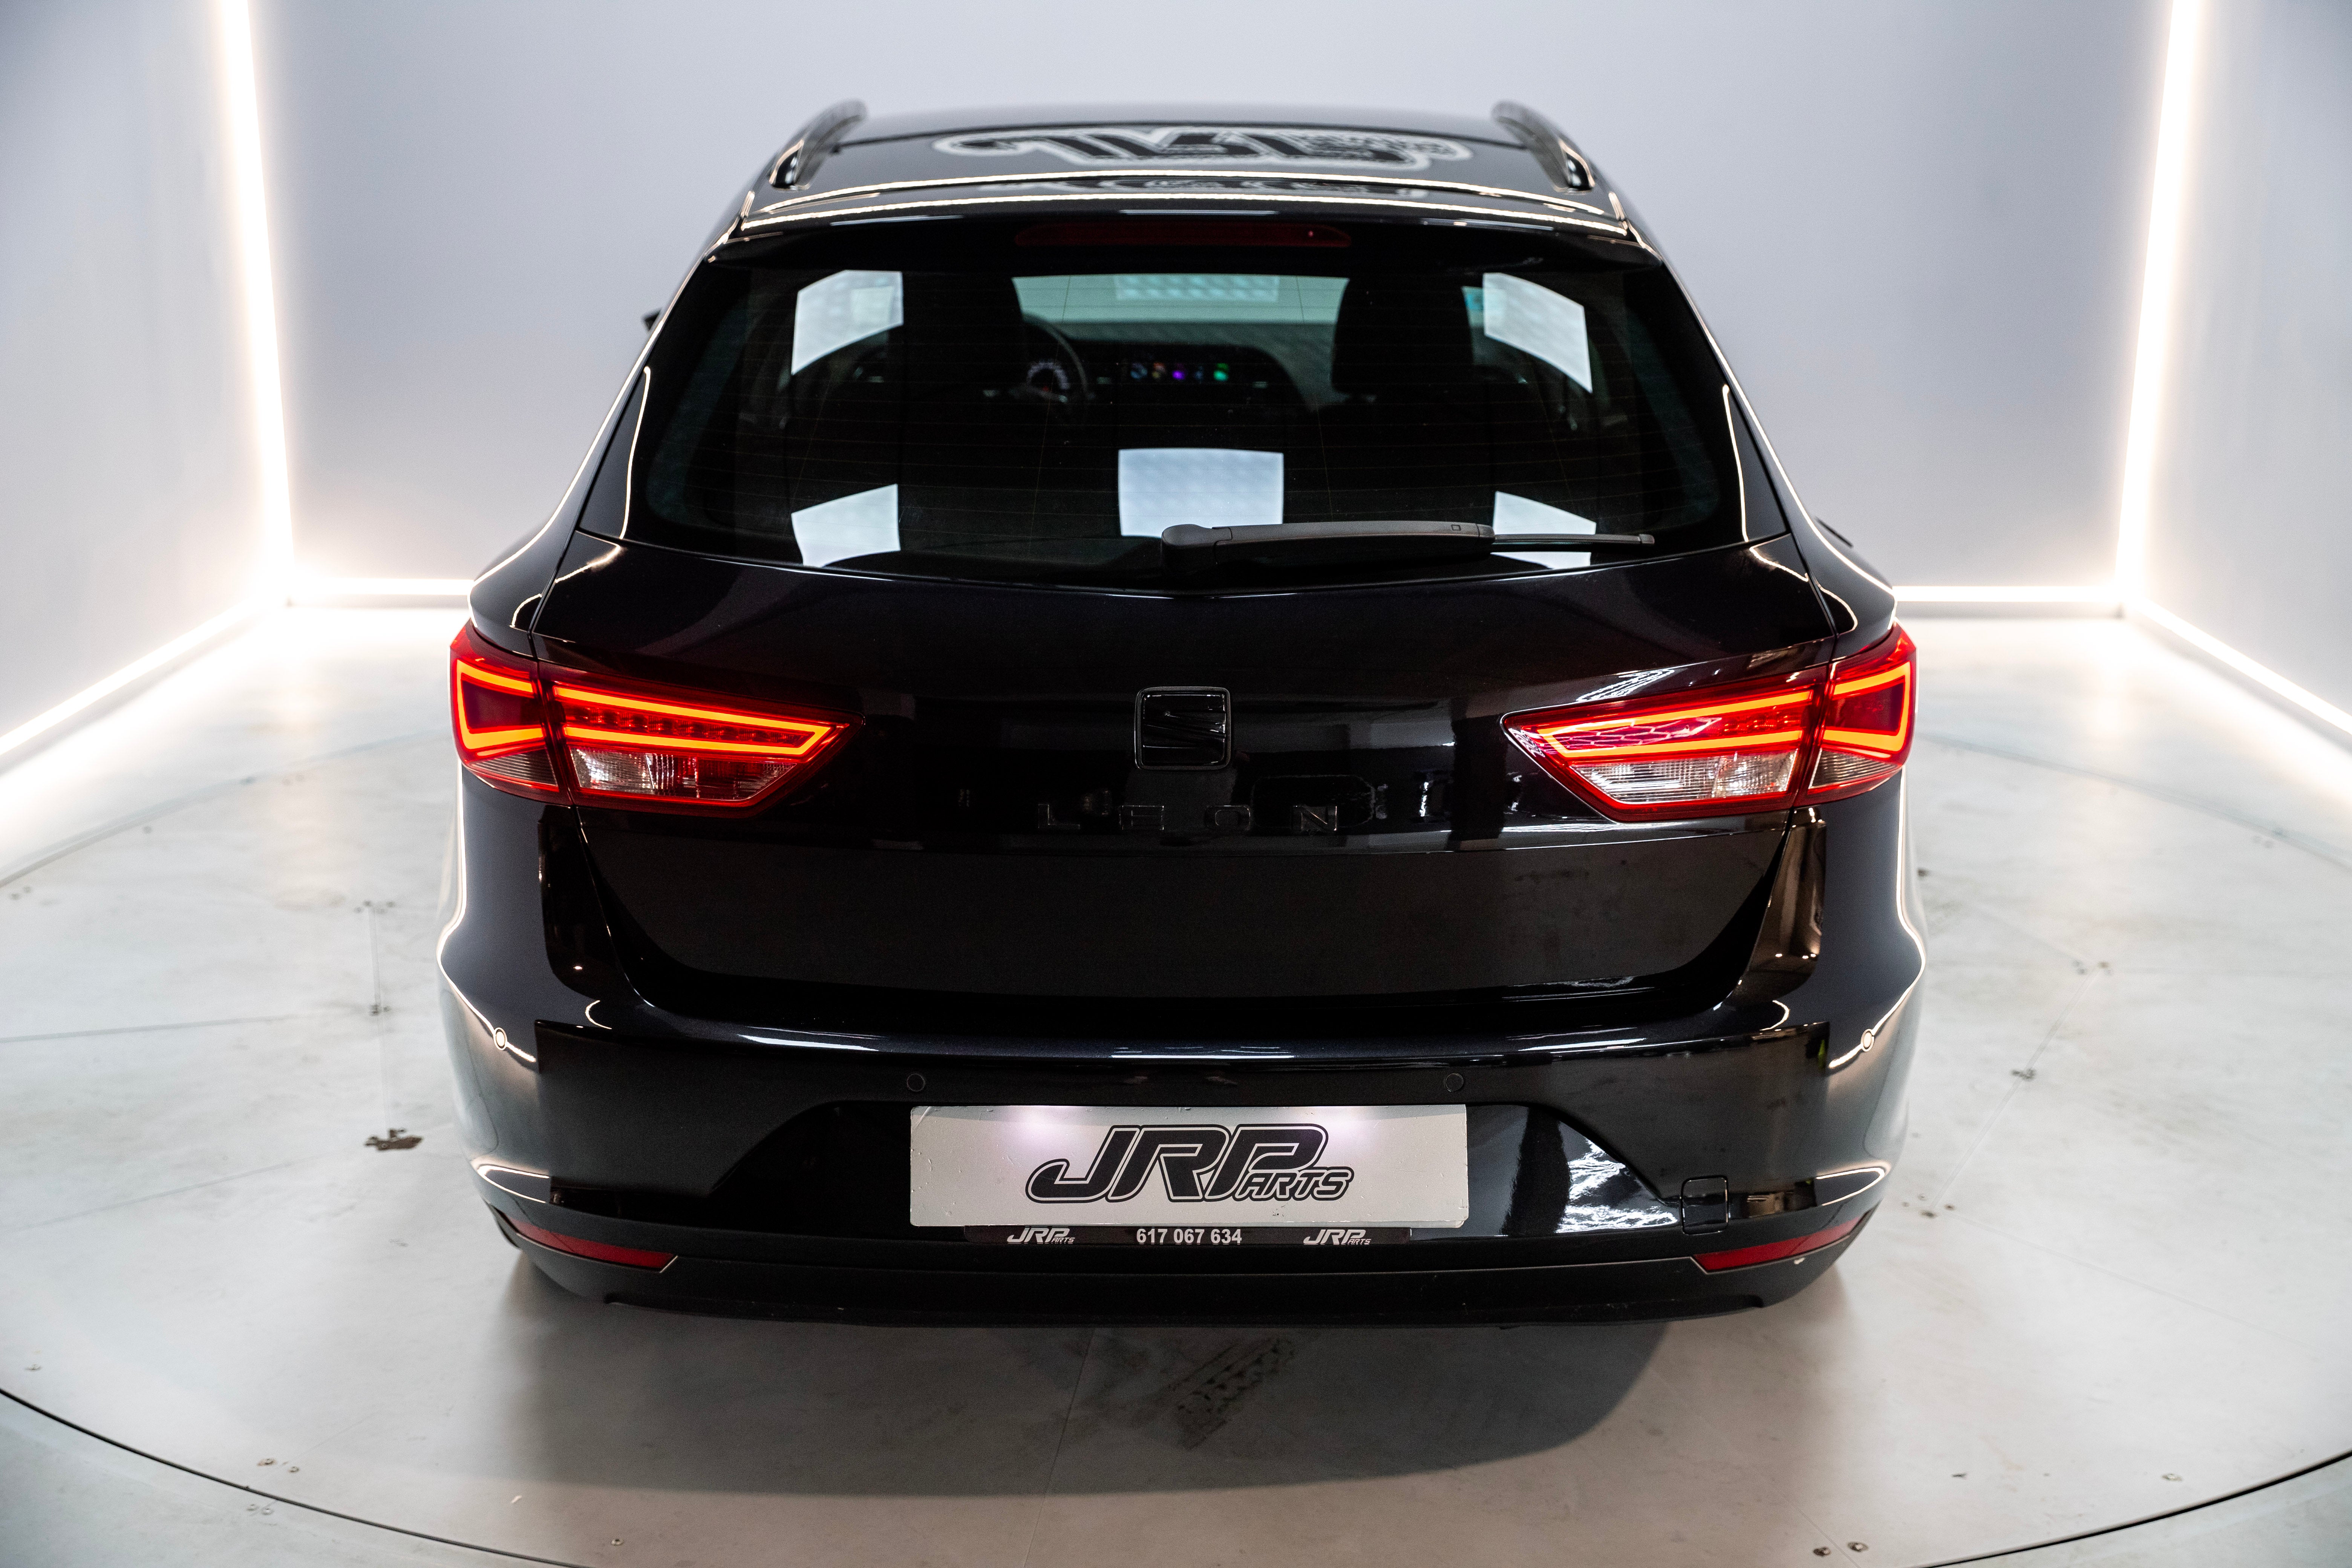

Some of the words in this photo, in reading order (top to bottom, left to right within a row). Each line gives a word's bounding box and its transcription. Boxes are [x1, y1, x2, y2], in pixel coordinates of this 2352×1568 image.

[1038, 803, 1338, 831] LEON
[1136, 1228, 1168, 1244] 617
[1173, 1229, 1205, 1244] 067
[1211, 1229, 1242, 1244] 634
